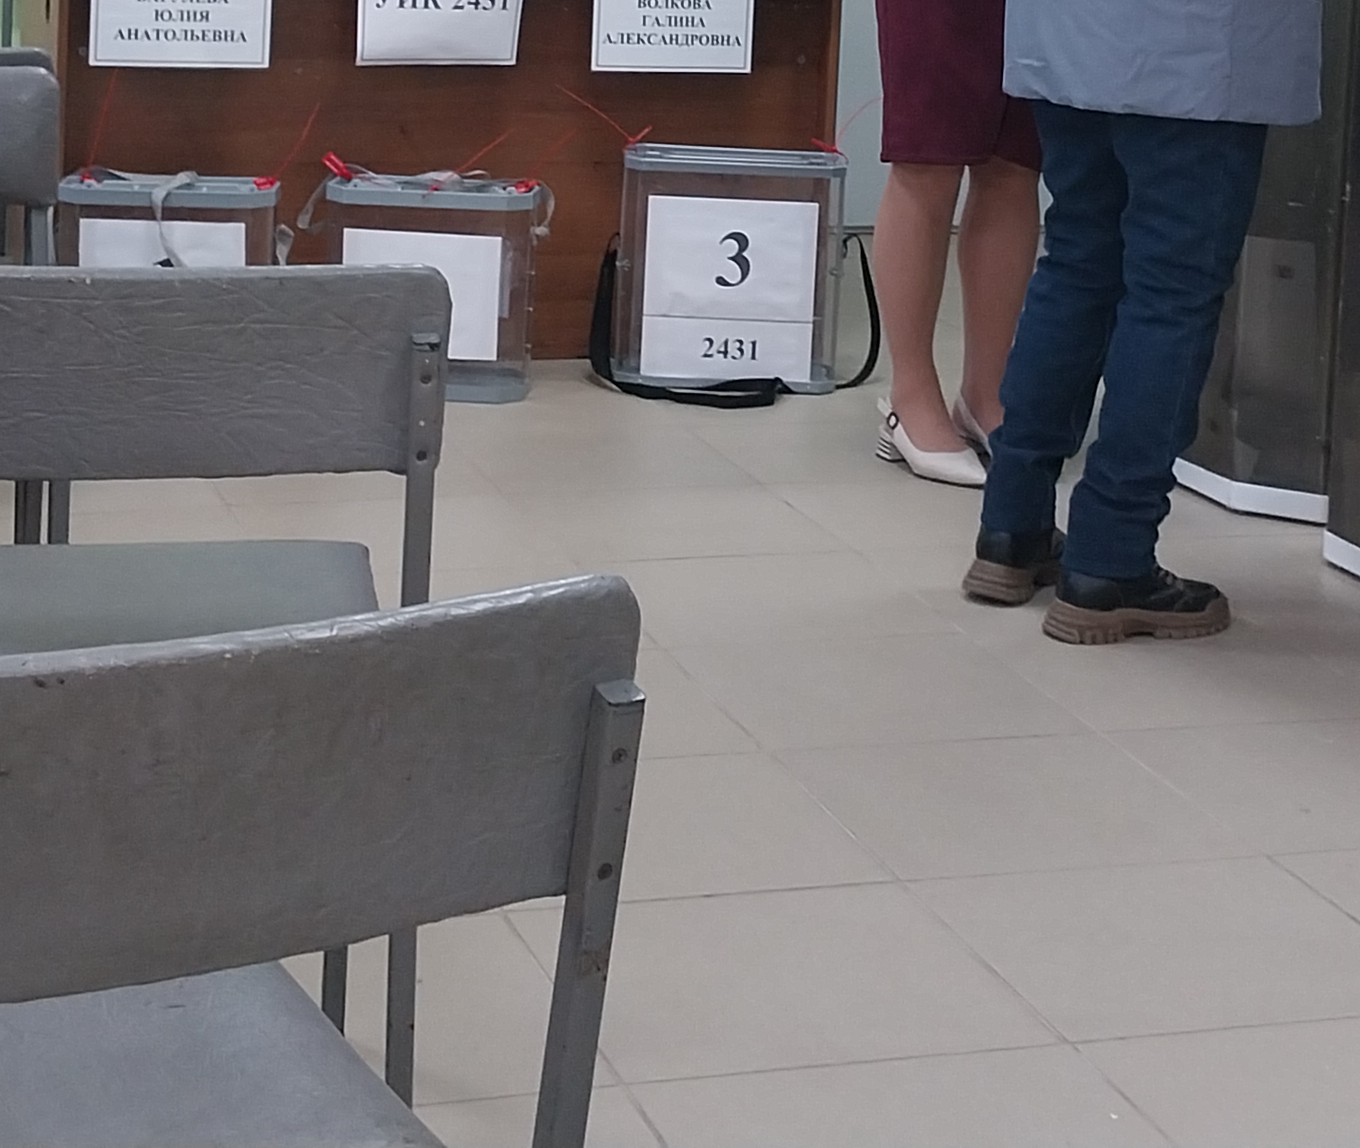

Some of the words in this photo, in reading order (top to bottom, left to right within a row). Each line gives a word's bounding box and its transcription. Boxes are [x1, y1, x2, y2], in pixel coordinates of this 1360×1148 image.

[153, 8, 211, 24] ЮЛИЯ
[641, 15, 706, 29] ГАЛИНА
[113, 27, 248, 44] АНАТОЛЬЕВНА
[601, 32, 742, 48] АЛЕКСАНДРОВНА
[714, 231, 751, 289] 3
[700, 337, 759, 363] 2431
